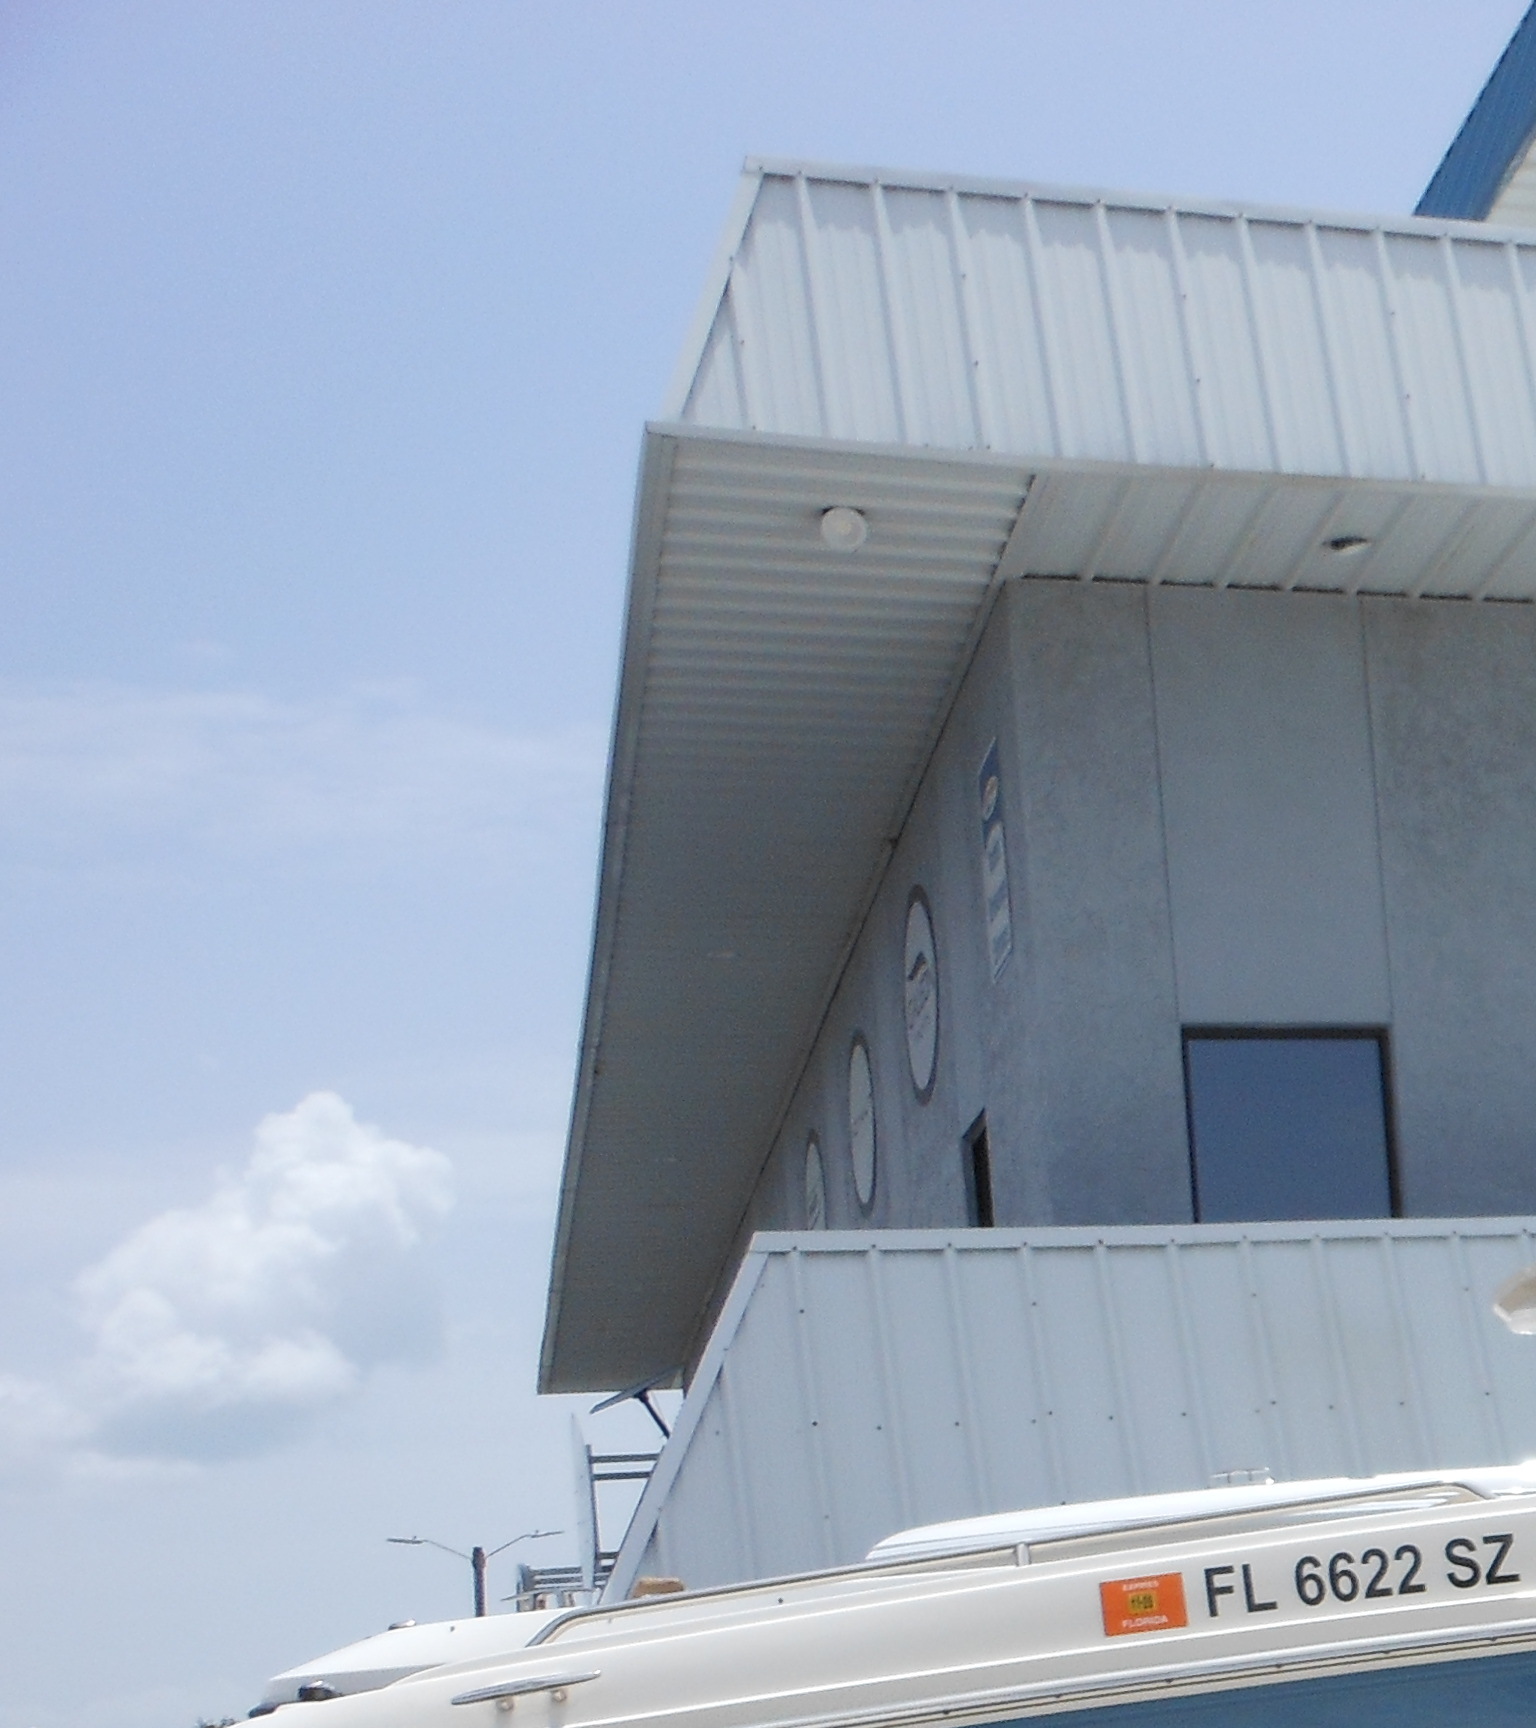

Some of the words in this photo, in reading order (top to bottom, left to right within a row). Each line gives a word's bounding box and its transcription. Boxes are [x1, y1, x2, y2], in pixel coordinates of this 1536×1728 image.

[1204, 1563, 1278, 1617] FL
[1295, 1544, 1427, 1606] 6622
[1445, 1533, 1521, 1588] SZ
[1121, 1614, 1169, 1629] FLORIDA
